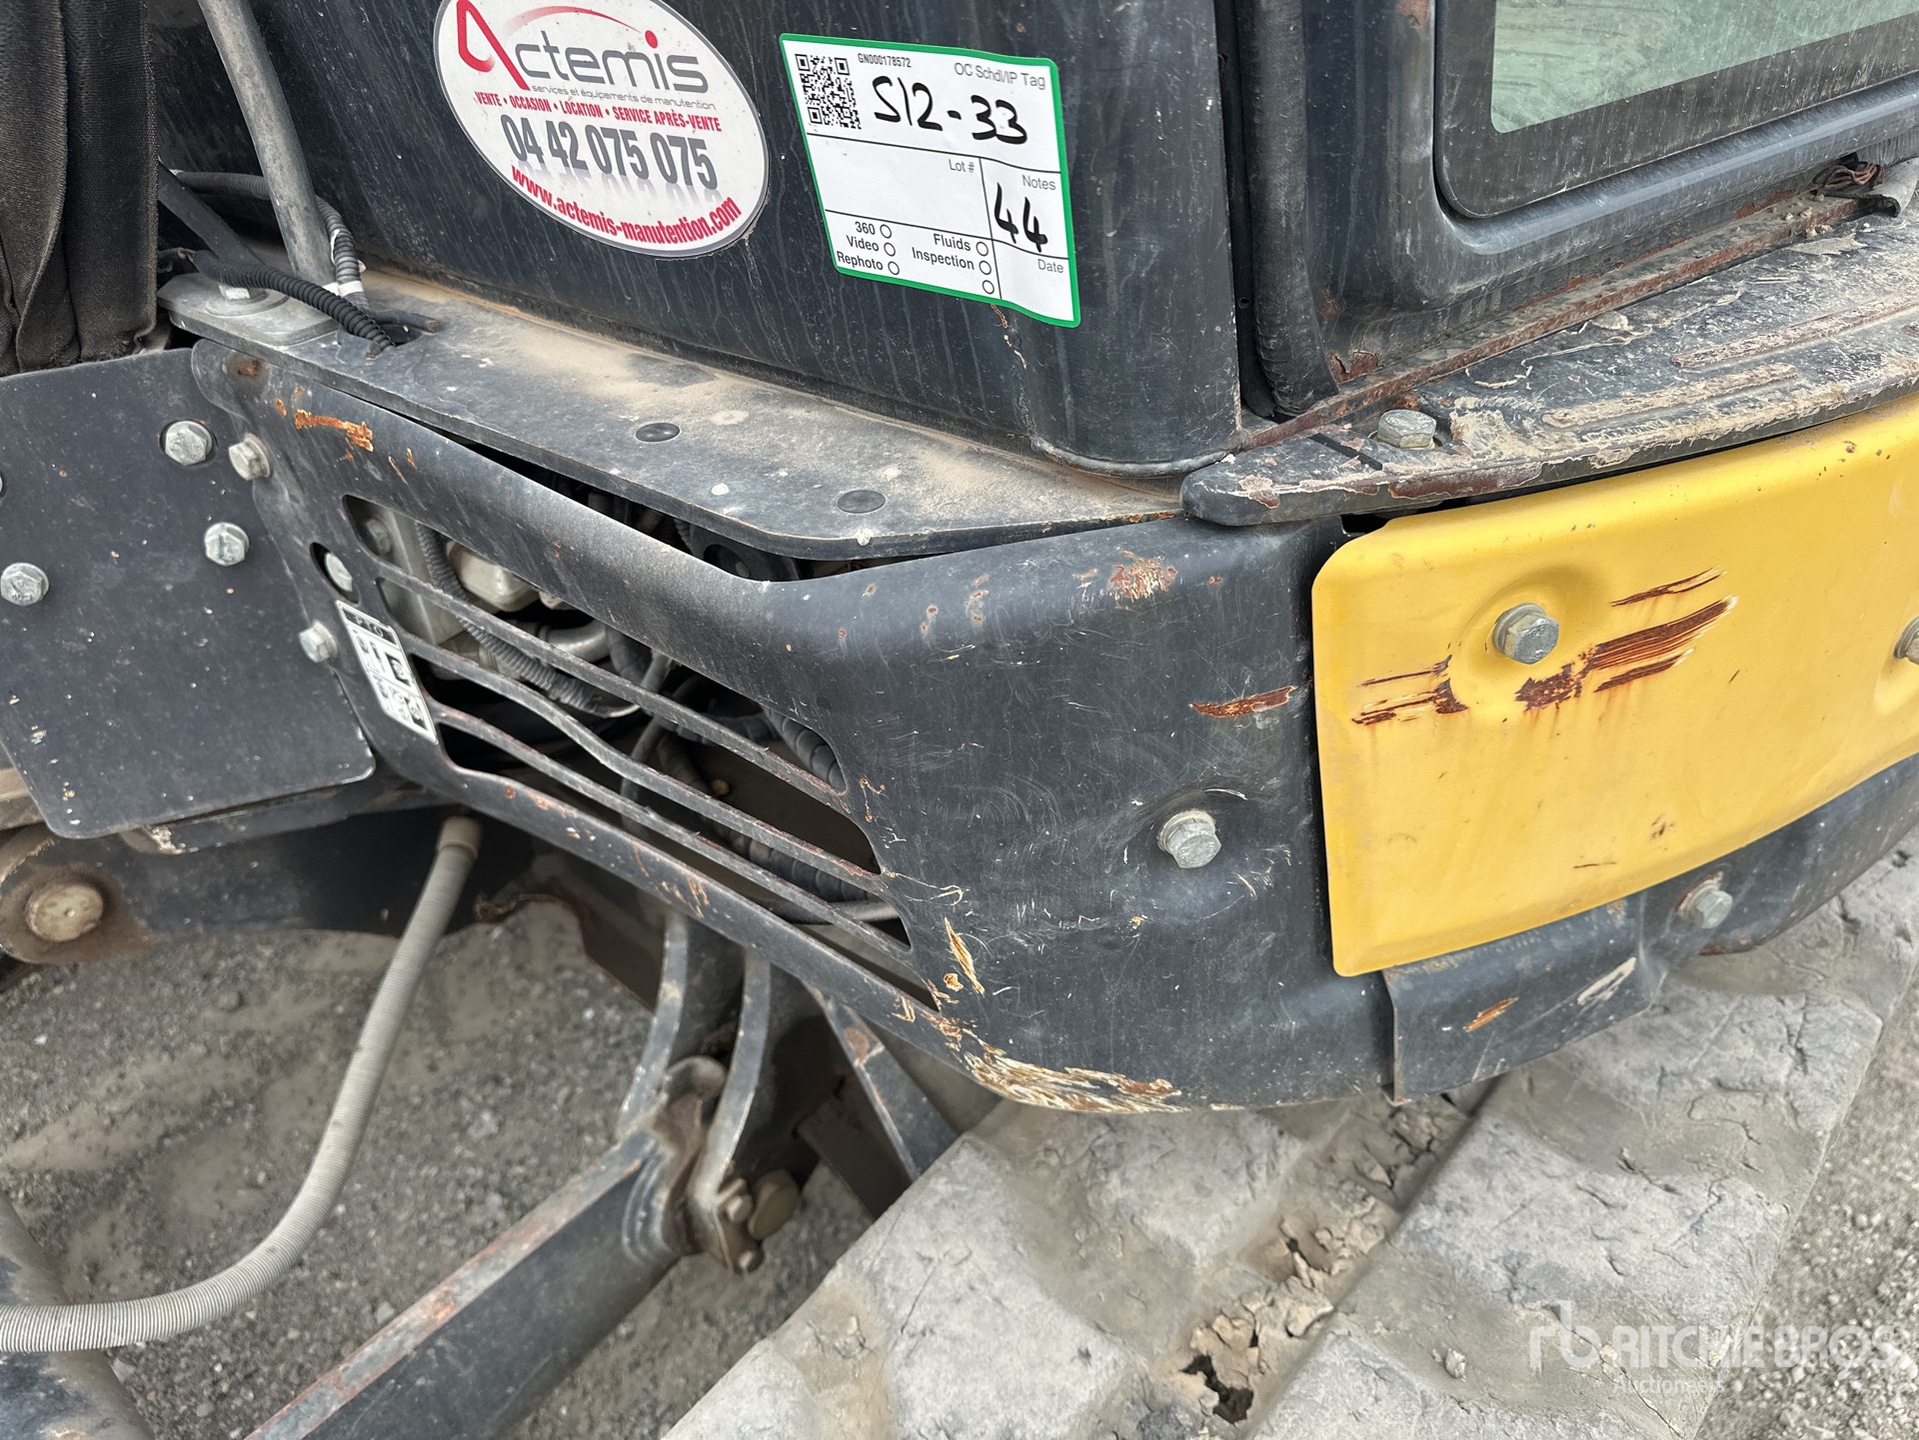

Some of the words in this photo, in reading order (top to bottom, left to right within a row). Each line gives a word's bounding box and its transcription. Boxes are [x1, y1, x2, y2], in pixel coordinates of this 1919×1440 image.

[857, 53, 912, 68] GN000178572
[954, 62, 974, 76] OC
[1020, 73, 1046, 90] Tag
[532, 85, 569, 96] services
[641, 95, 653, 103] de
[654, 97, 716, 111] manutention
[475, 91, 503, 107] VENTE
[509, 95, 552, 112] OCCASION
[560, 100, 603, 118] LOCATION
[612, 106, 653, 124] SERVICE
[654, 109, 722, 132] APRÈS-VENTE
[500, 114, 546, 165] 04
[545, 120, 589, 171] 42
[585, 125, 649, 180] 075
[650, 132, 718, 190] 075
[948, 159, 967, 172] Lot
[968, 161, 975, 173] #
[1022, 174, 1056, 191] Notes
[511, 165, 742, 245] www.actemis-manutention.com
[993, 182, 1048, 252] 44
[855, 222, 875, 235] 360
[846, 235, 879, 252] Video
[933, 233, 972, 252] Fluids
[837, 251, 884, 271] Rephoto
[911, 247, 975, 270] Inspection
[1037, 259, 1064, 274] Date
